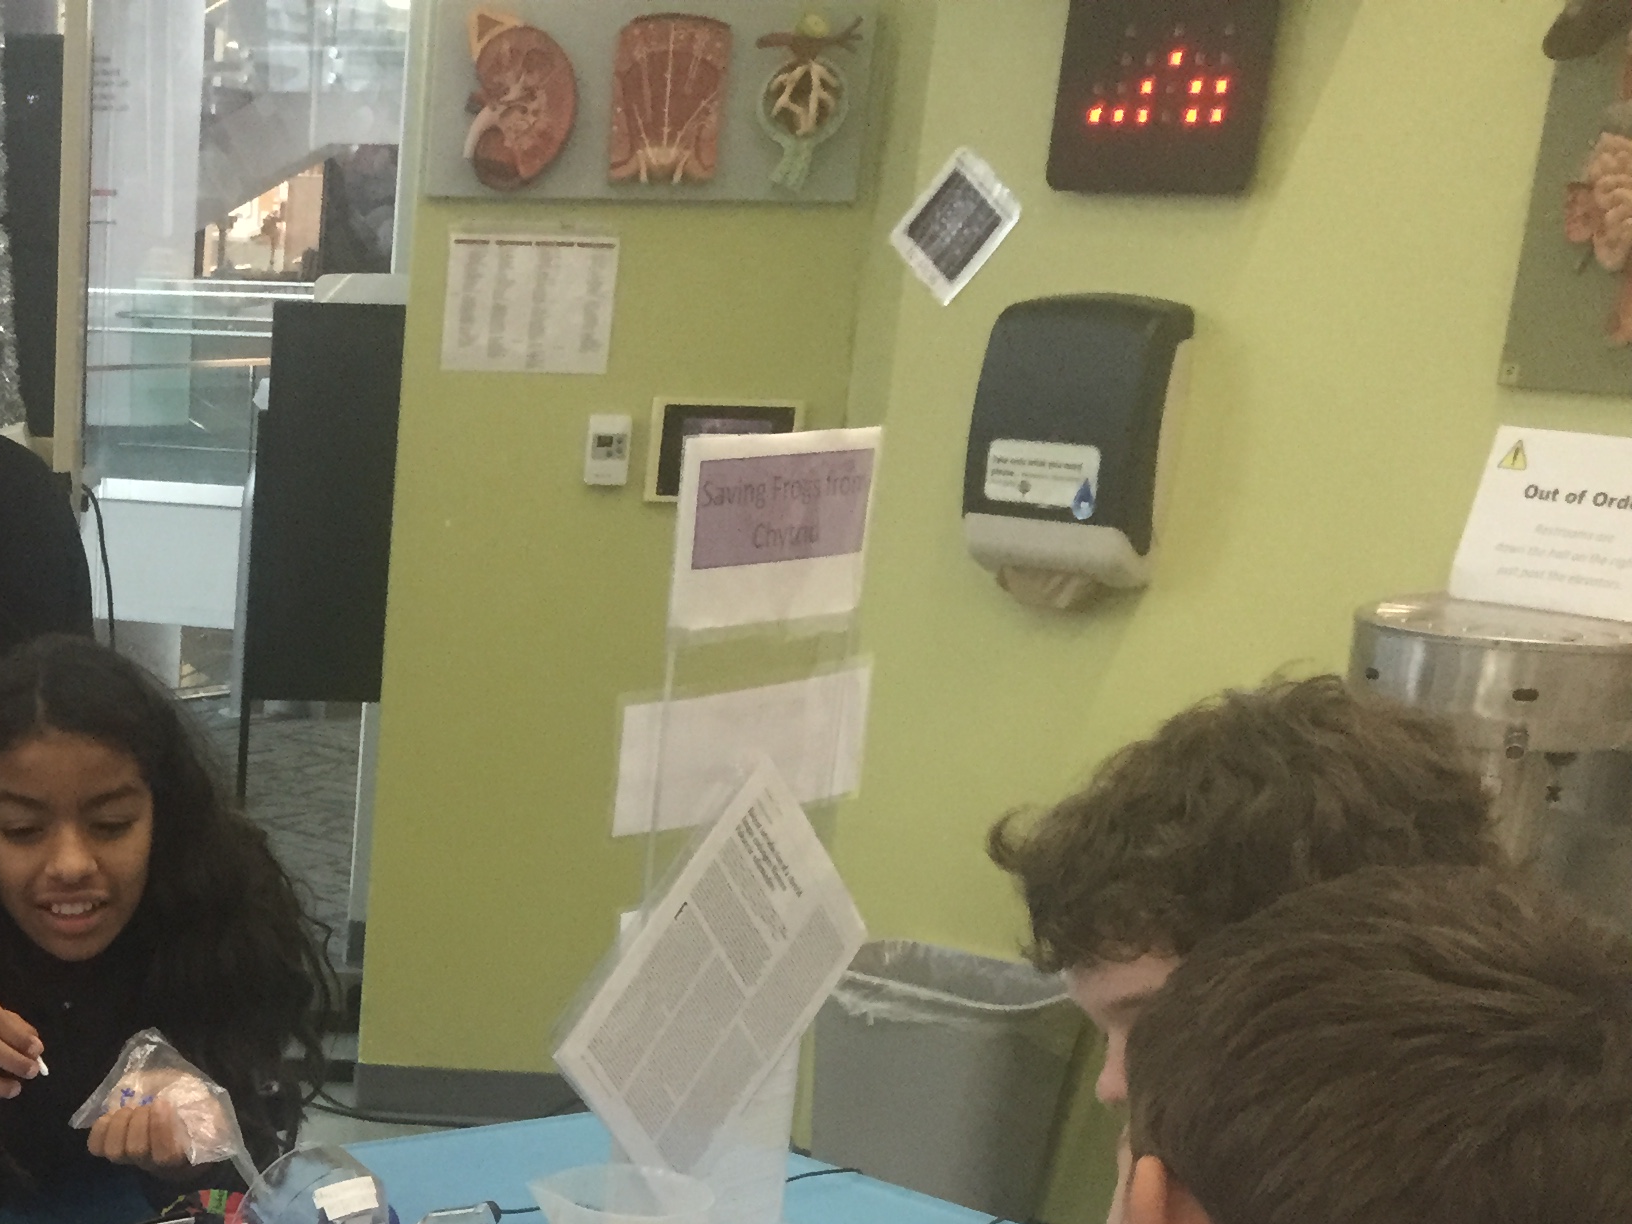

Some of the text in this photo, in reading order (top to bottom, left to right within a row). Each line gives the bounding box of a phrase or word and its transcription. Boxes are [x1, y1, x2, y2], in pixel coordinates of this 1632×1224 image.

[701, 477, 768, 509] Saving
[772, 475, 821, 504] Frogs
[1524, 484, 1559, 501] Out
[1565, 490, 1587, 505] of
